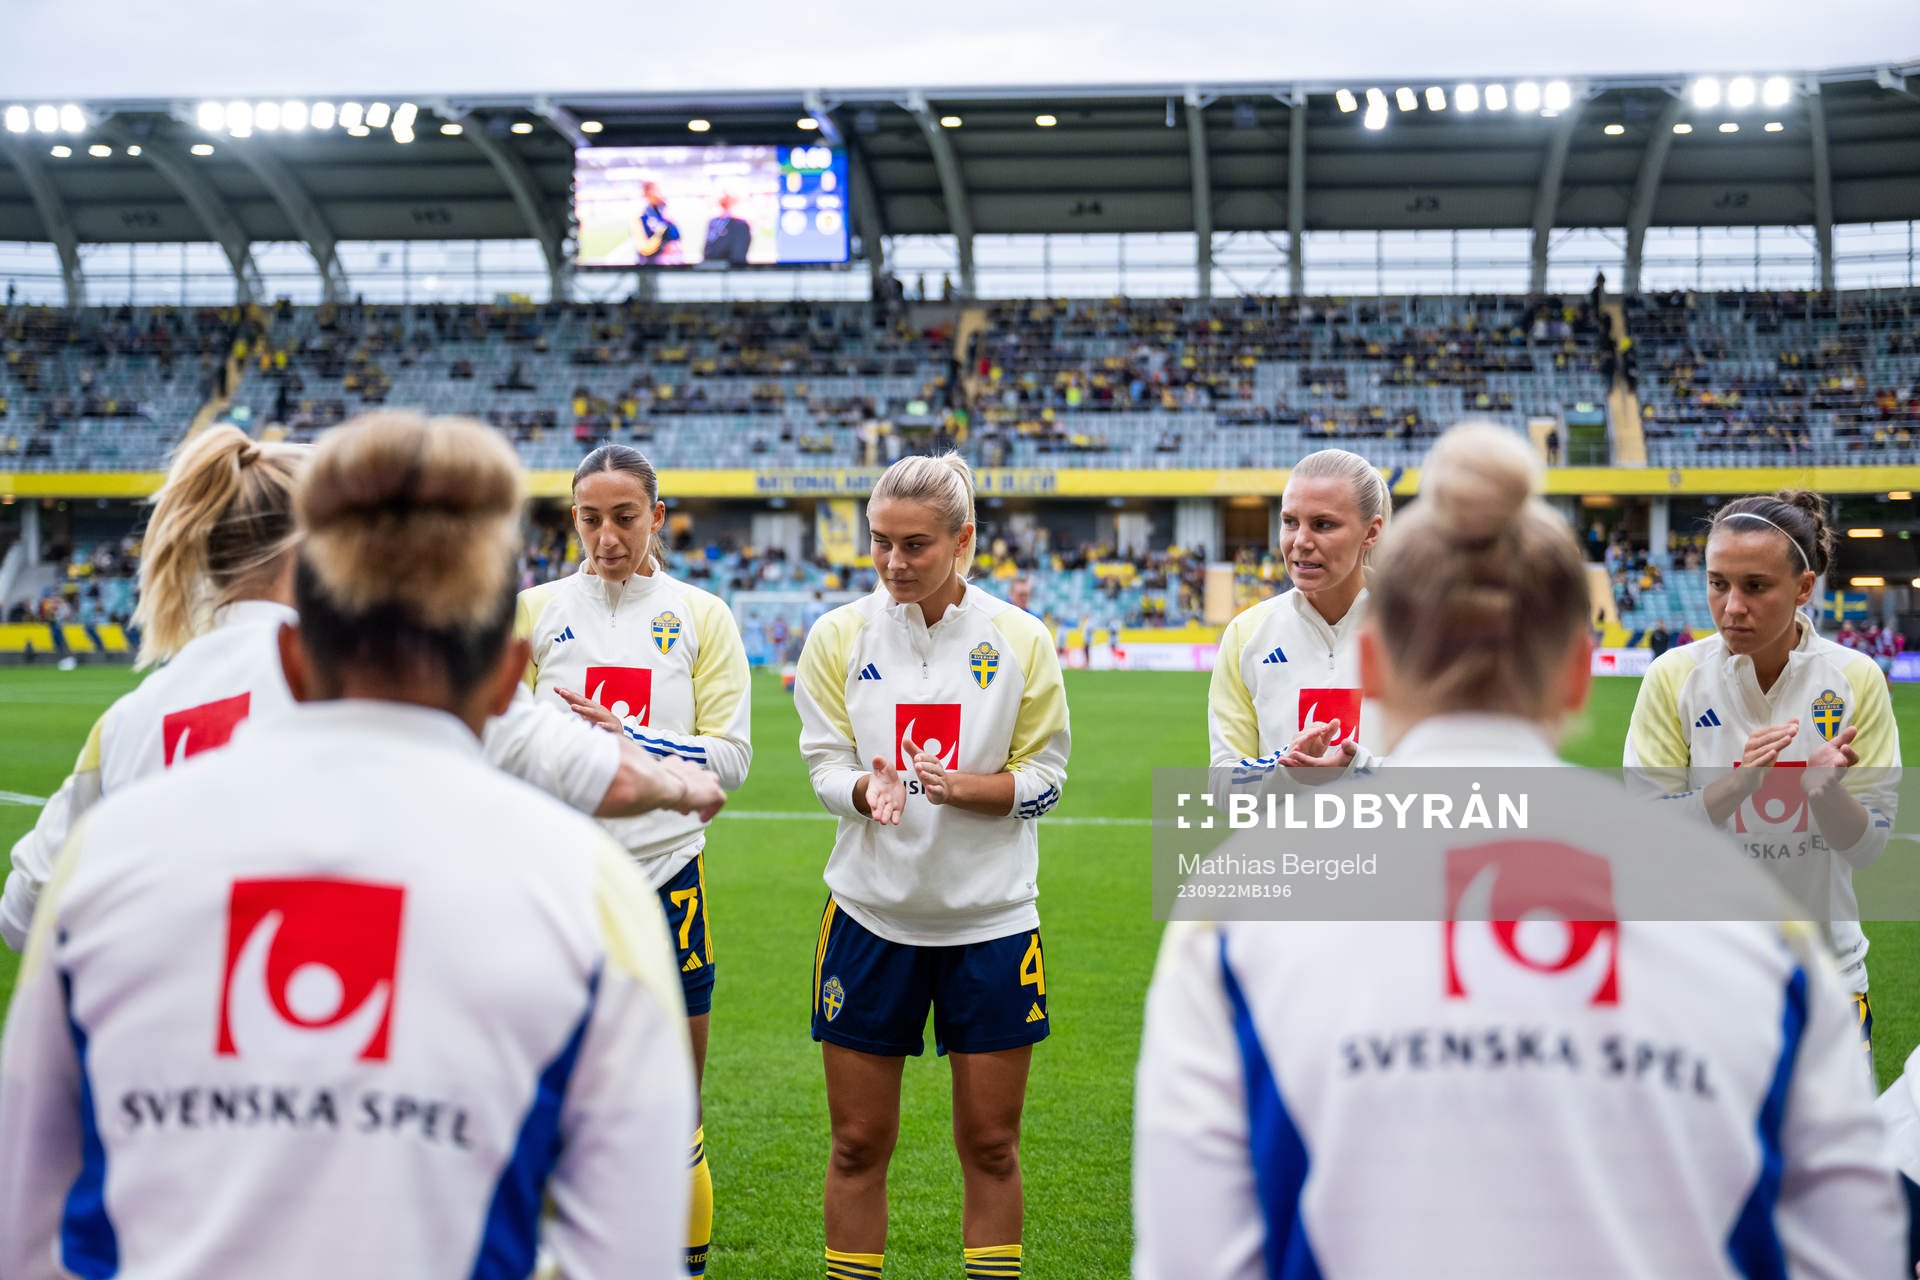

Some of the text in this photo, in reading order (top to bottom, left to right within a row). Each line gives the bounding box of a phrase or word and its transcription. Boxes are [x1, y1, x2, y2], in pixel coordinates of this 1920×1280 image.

[670, 887, 698, 949] 7
[1020, 934, 1045, 995] 4
[1341, 1029, 1717, 1100] SVENSKA SPEL
[120, 1087, 473, 1149] SVENSKA SPEL
